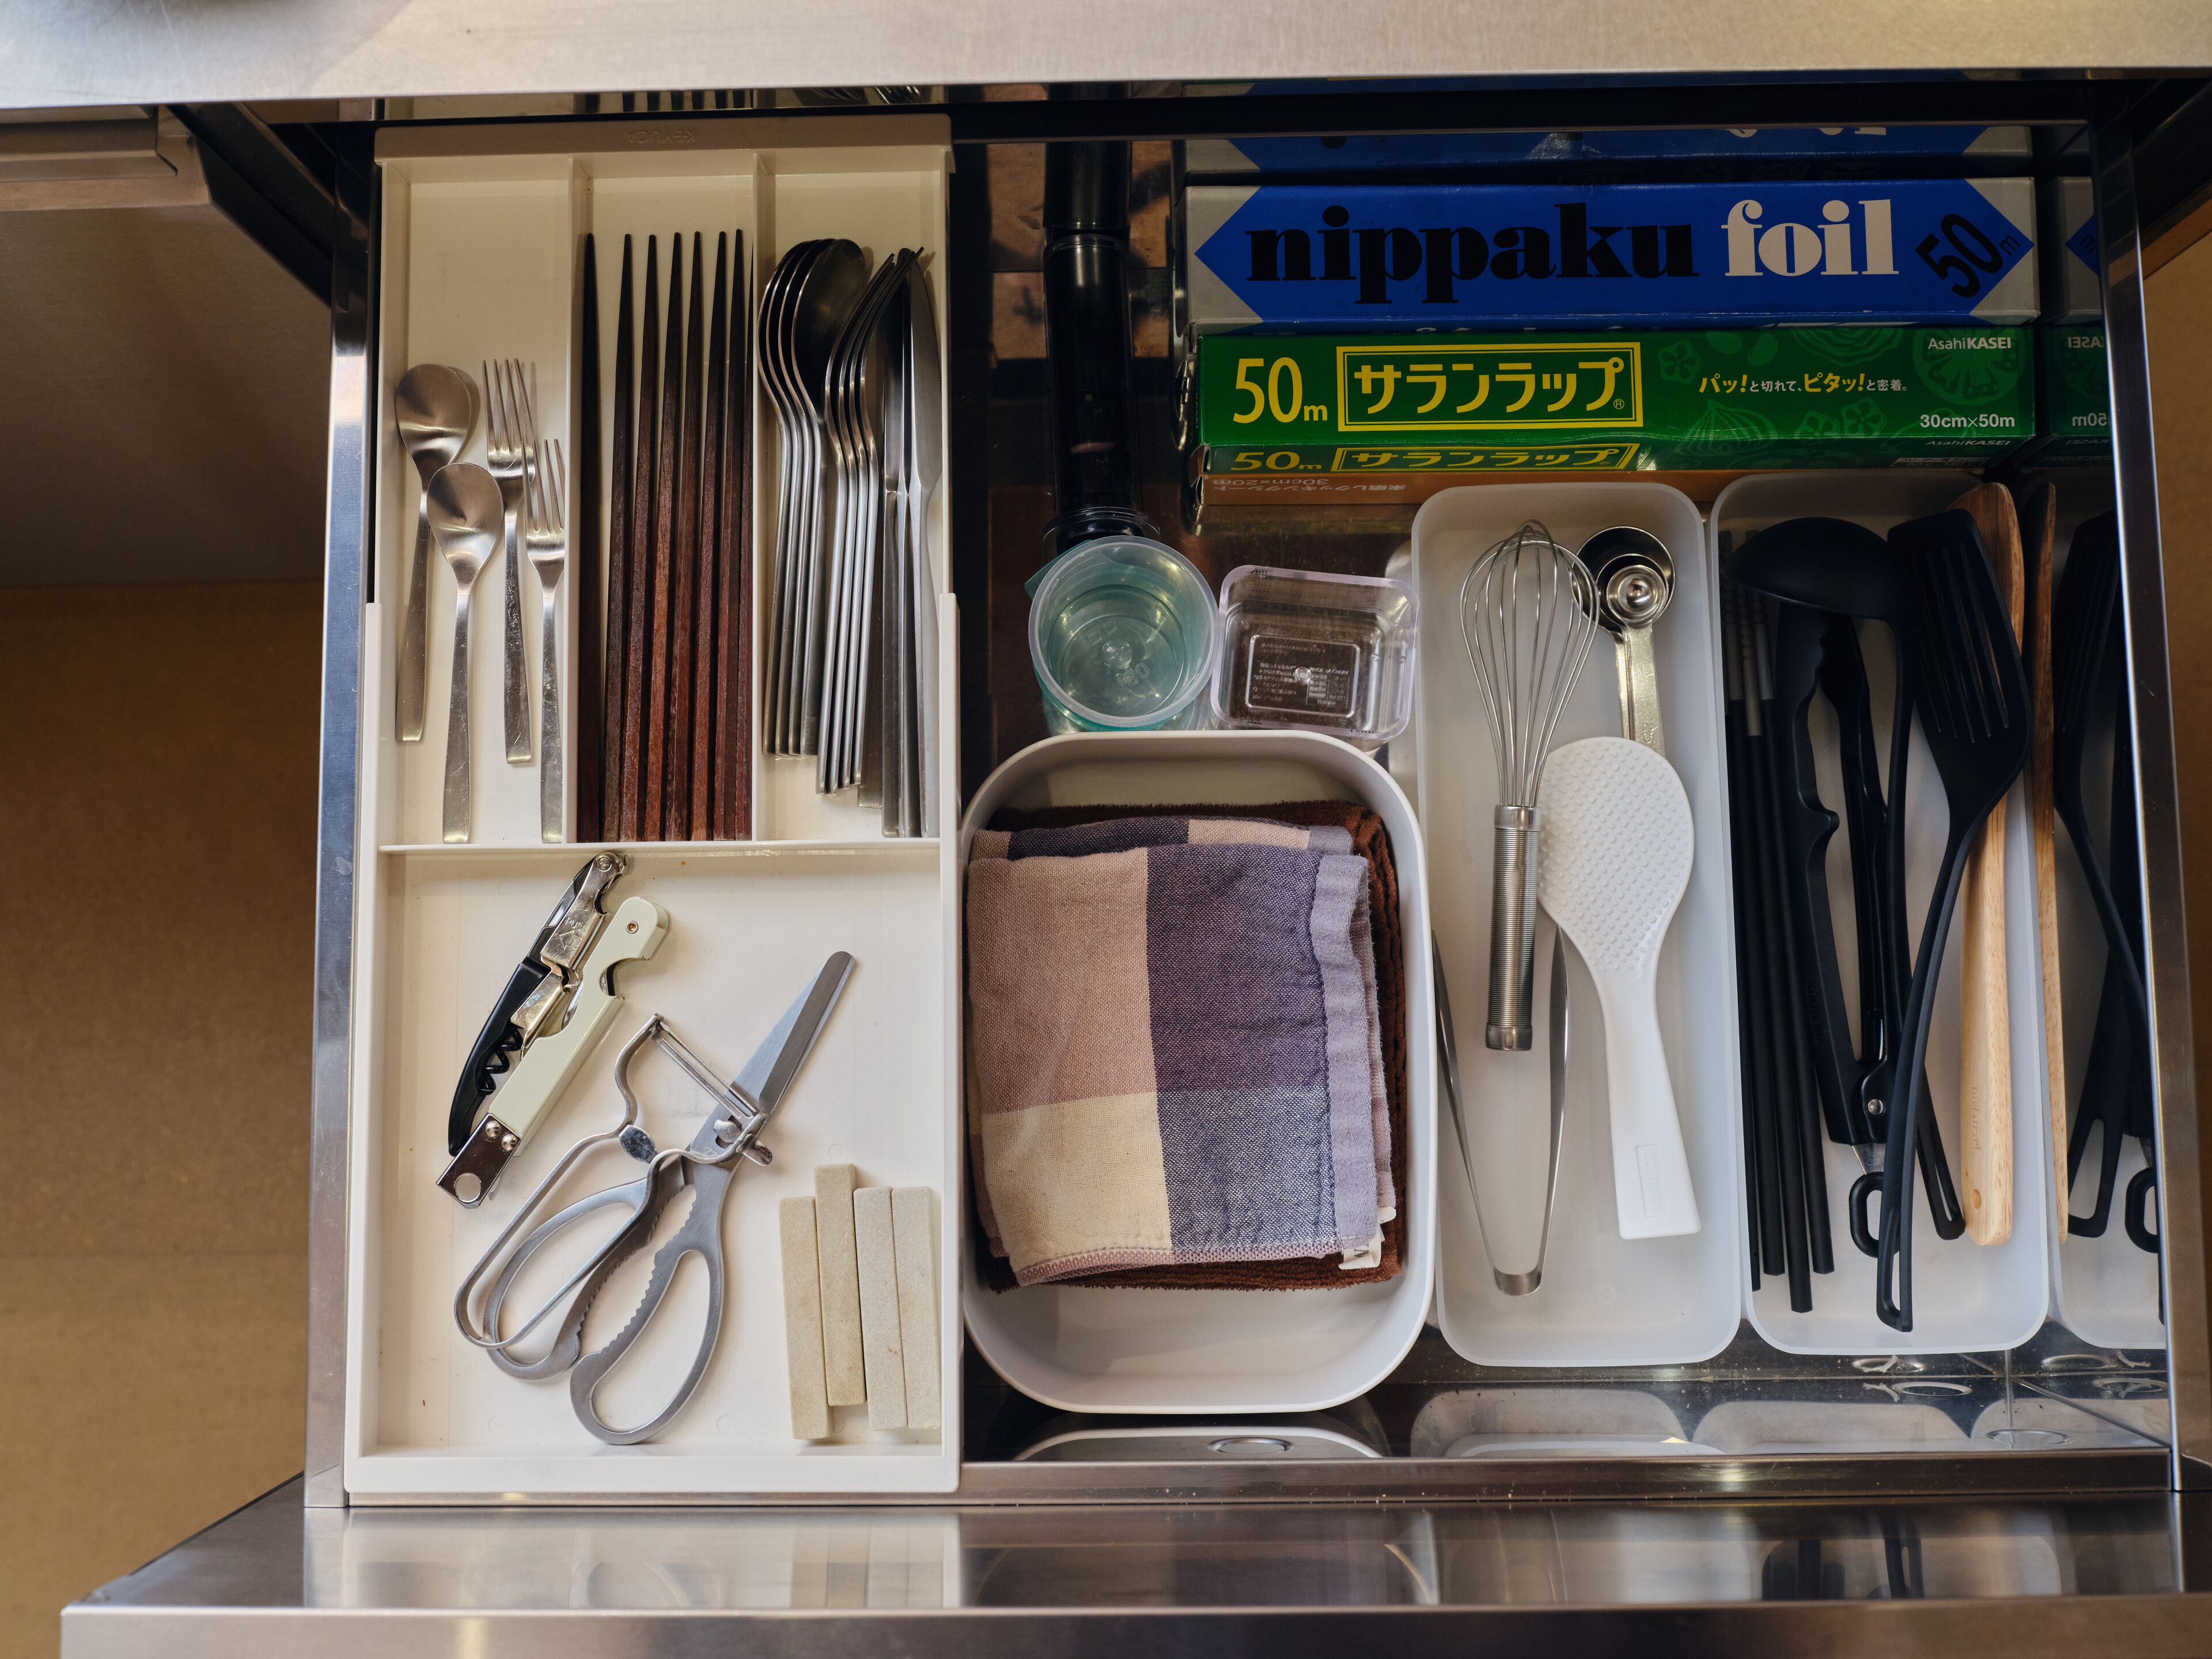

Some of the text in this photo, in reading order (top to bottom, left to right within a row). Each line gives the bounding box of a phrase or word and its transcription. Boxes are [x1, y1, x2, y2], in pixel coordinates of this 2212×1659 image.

[625, 128, 696, 143] KEYUCA
[1245, 203, 1700, 304] nippaku
[1721, 199, 1899, 276] foil
[1928, 337, 2012, 350] AsahiKASEI
[1233, 357, 1328, 423] 50m
[1230, 452, 1322, 471] 50m
